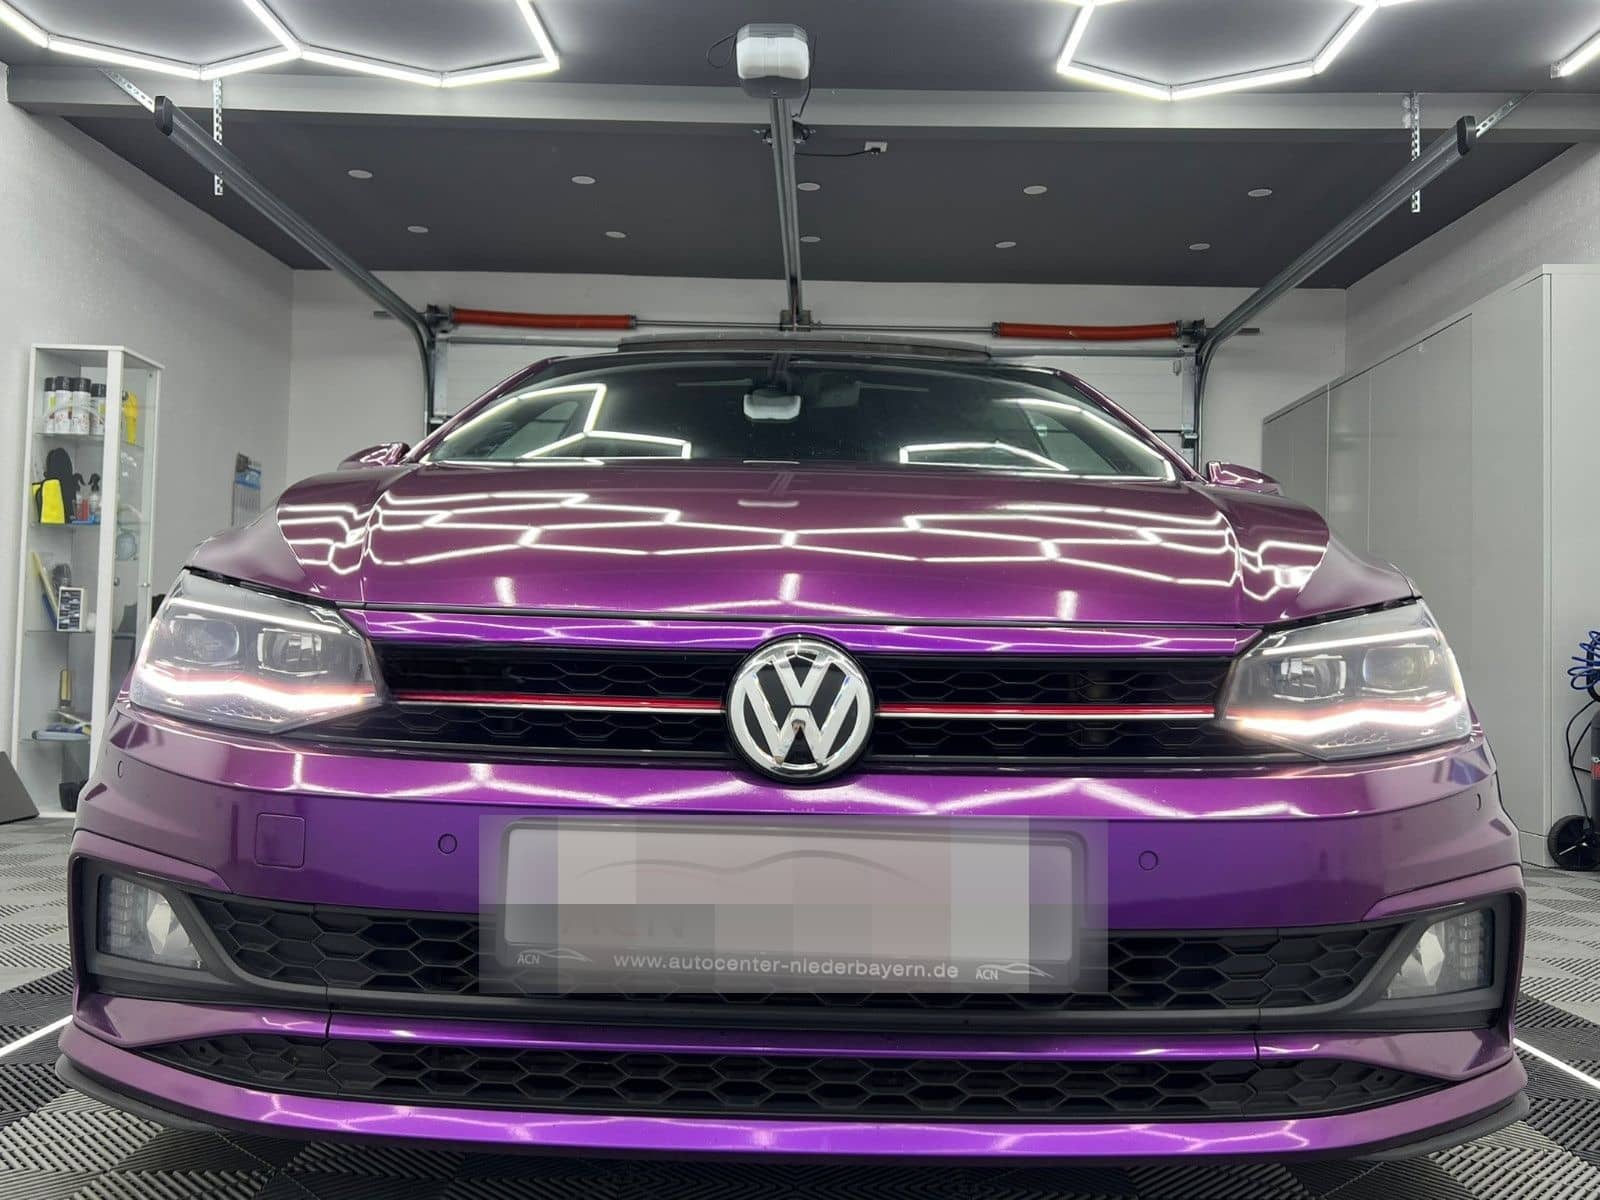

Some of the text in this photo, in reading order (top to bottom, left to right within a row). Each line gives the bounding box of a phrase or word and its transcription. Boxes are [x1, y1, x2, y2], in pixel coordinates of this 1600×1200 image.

[739, 648, 866, 770] VW
[516, 953, 541, 965] ACN
[613, 954, 960, 979] www.autocenter-niederbayern.de
[975, 968, 999, 981] ACN
